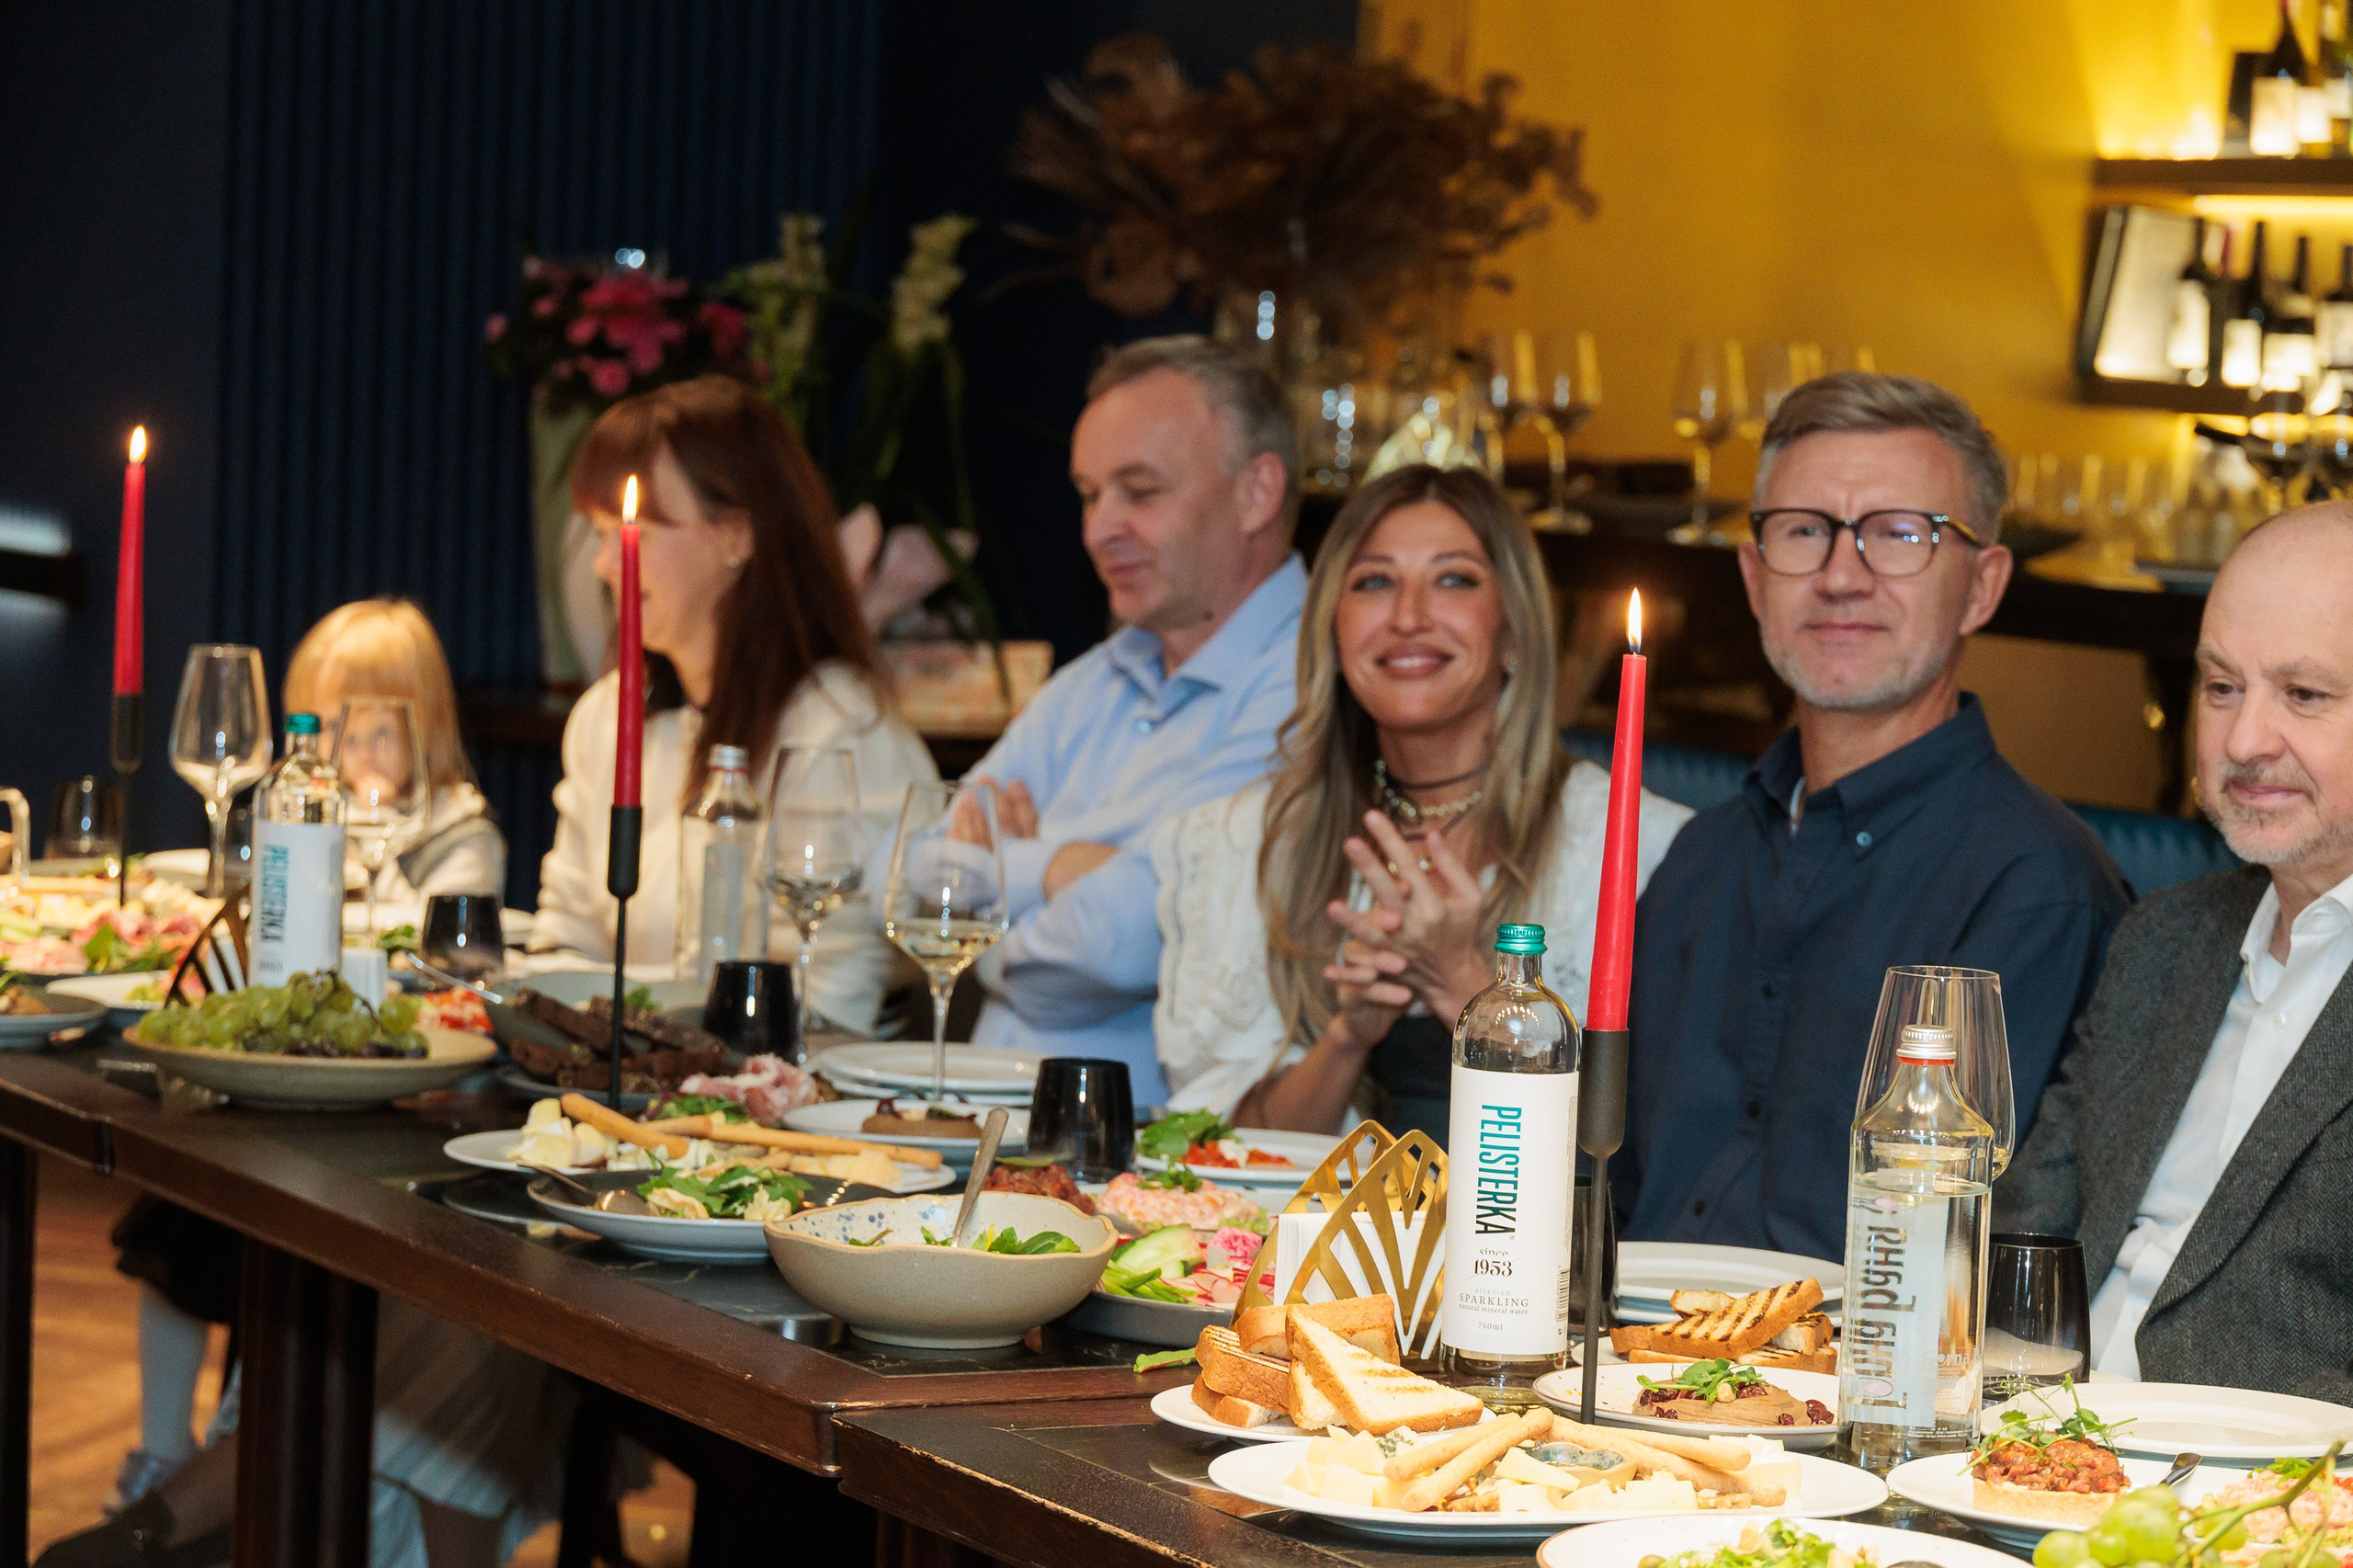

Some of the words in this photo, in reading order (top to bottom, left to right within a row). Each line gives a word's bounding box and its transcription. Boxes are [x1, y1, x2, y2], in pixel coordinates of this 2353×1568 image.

[1475, 1104, 1522, 1234] PELISTERKA
[1474, 1258, 1513, 1278] 1953
[1474, 1287, 1511, 1297] artesian
[1459, 1292, 1529, 1308] SPARKLING
[1459, 1303, 1480, 1312] natural
[1481, 1306, 1507, 1314] mineral
[1477, 1322, 1504, 1331] 750ml
